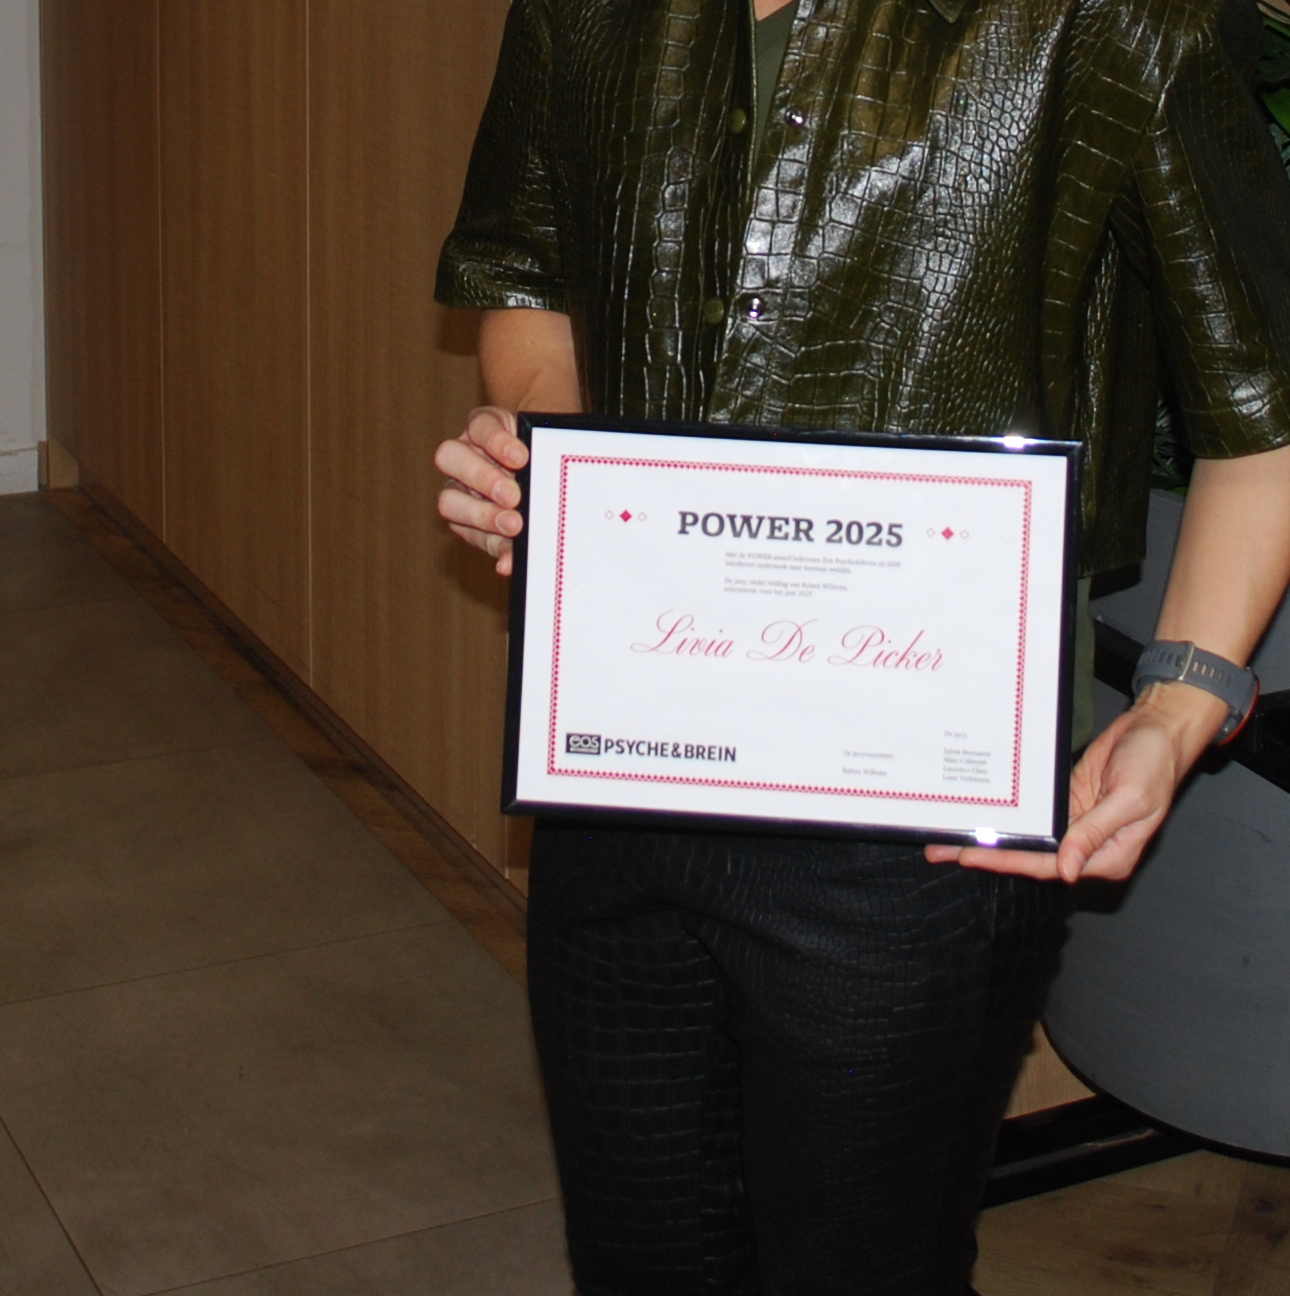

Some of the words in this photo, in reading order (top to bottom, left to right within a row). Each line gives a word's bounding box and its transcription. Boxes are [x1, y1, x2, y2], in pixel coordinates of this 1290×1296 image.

[677, 511, 814, 543] POWER
[825, 519, 903, 548] 2025
[747, 552, 772, 560] POWER
[767, 579, 788, 588] leiding
[630, 609, 733, 657] Livia
[746, 618, 817, 663] De
[827, 625, 943, 672] Picker
[604, 738, 736, 763] PSYCHE&BREIN
